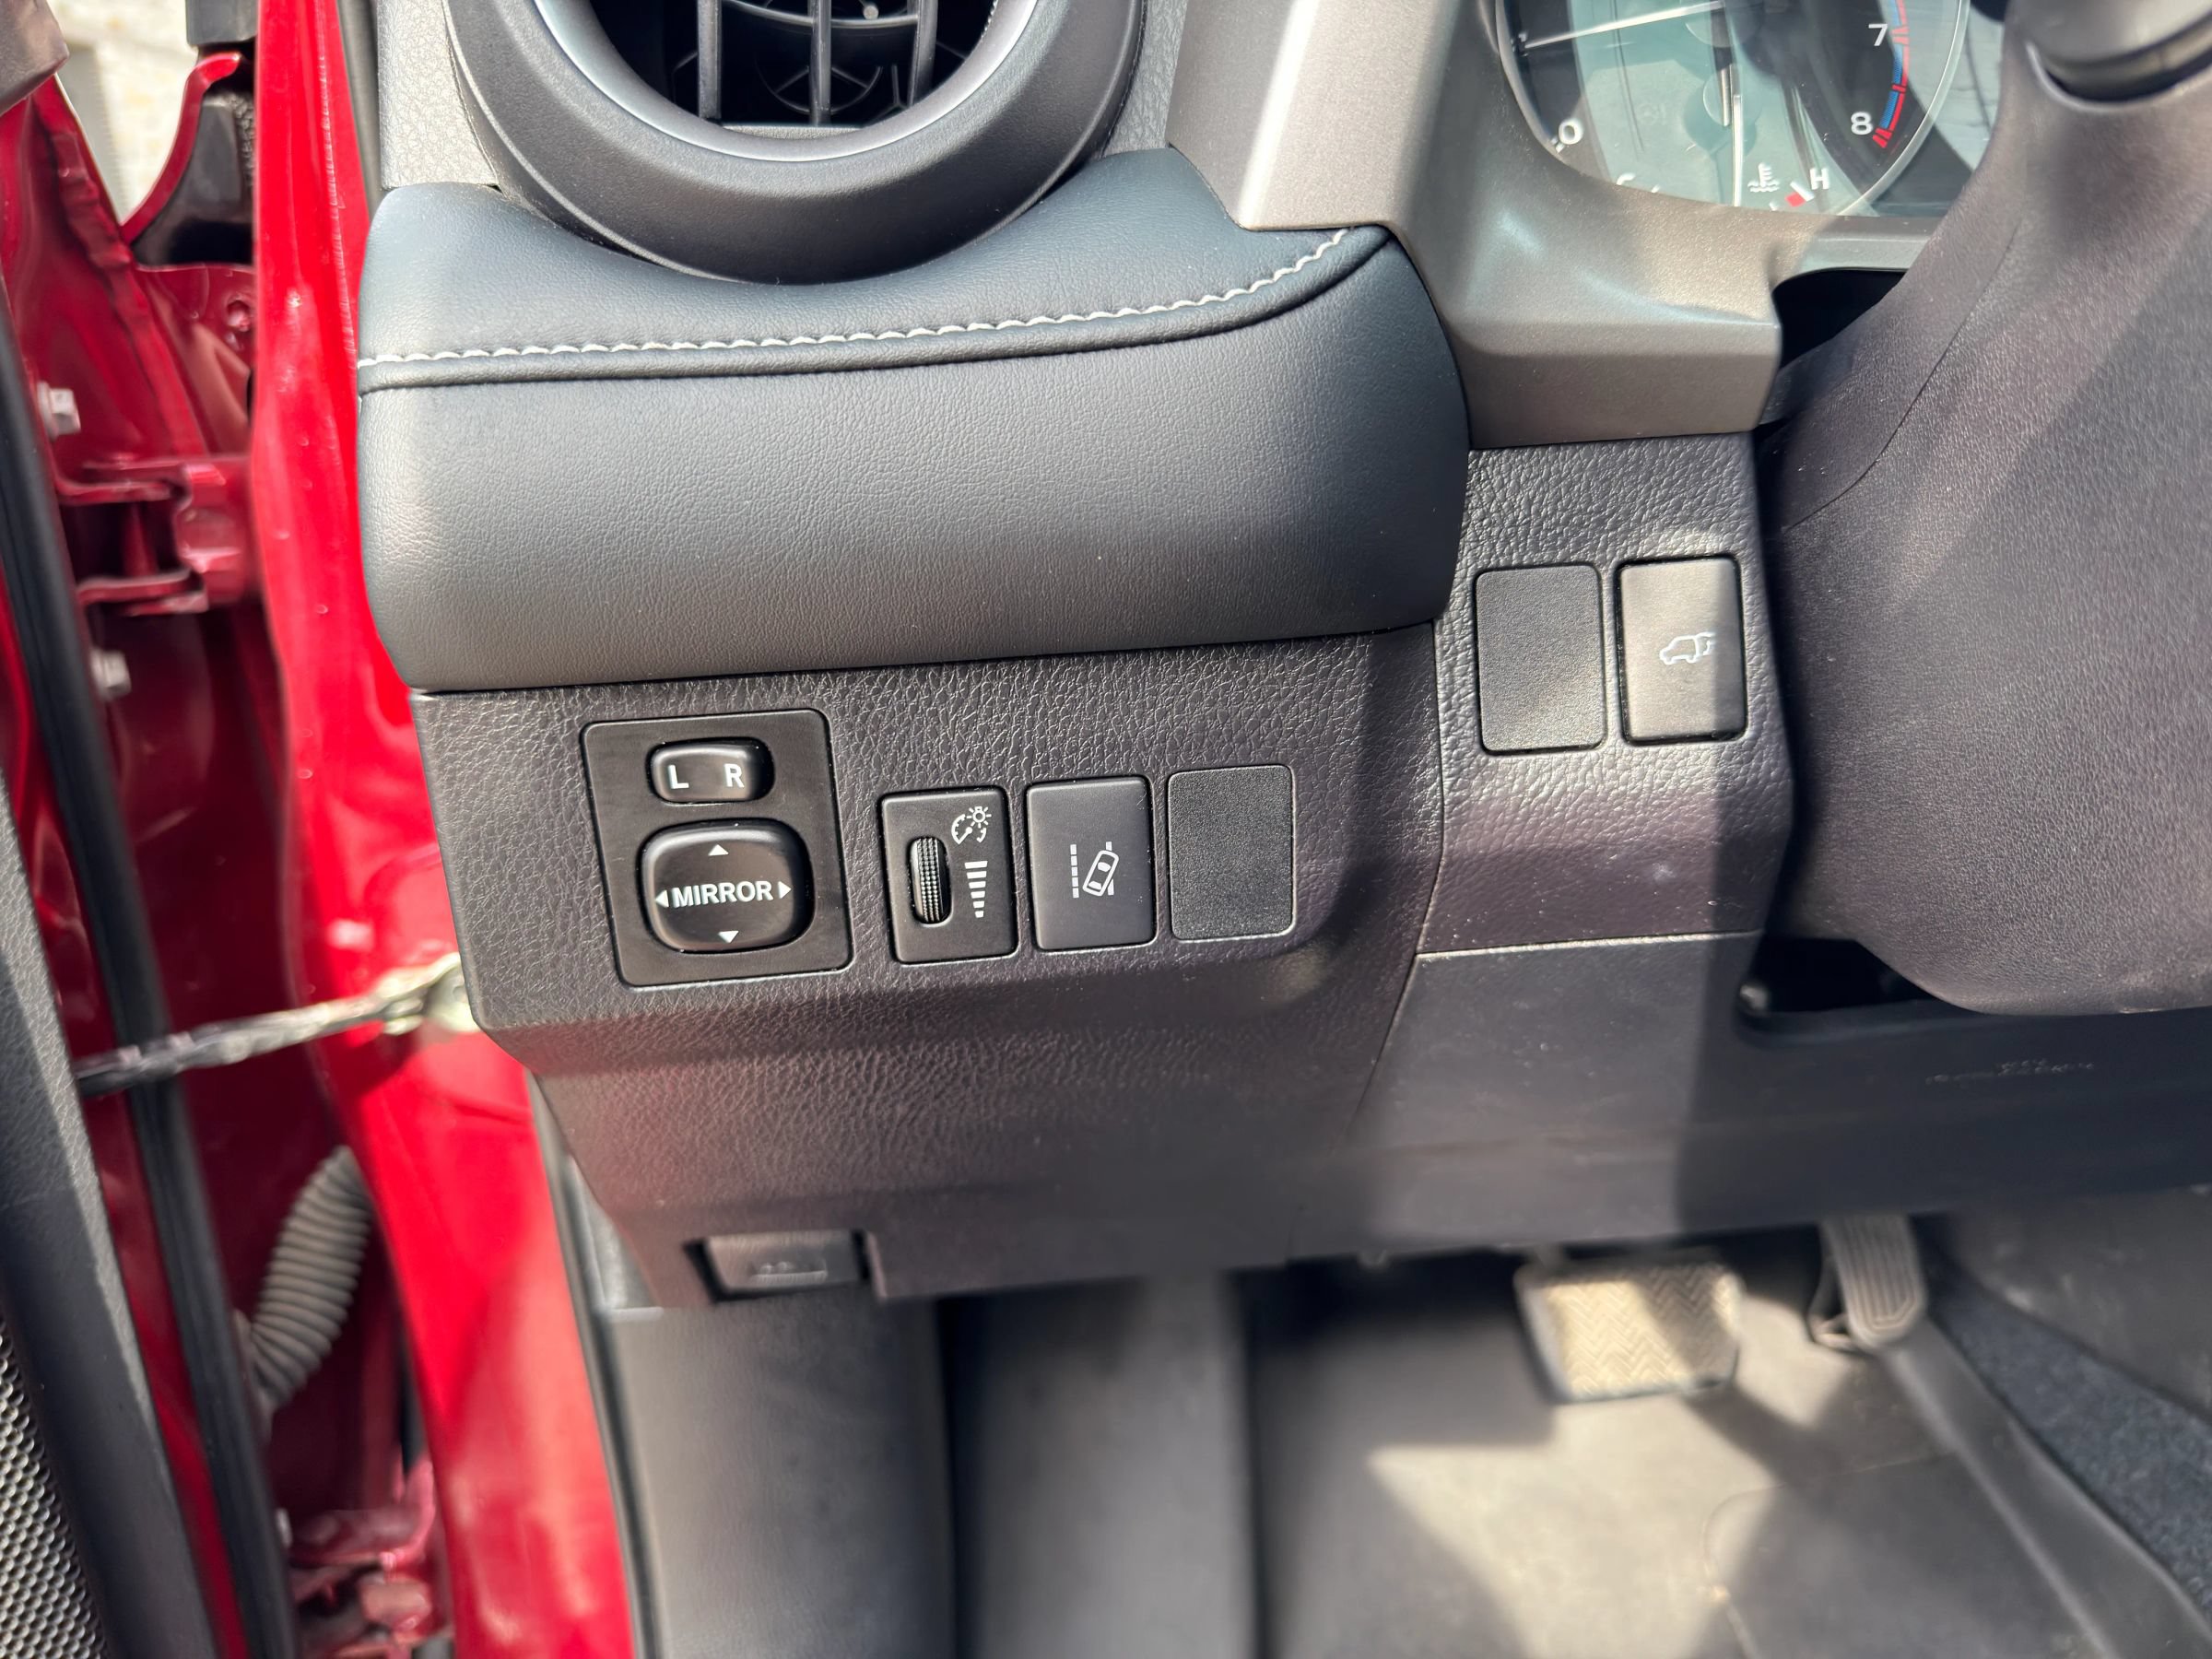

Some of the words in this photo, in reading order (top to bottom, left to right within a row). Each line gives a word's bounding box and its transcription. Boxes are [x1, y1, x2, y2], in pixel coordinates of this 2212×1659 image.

[1868, 23, 1888, 47] 7
[1850, 112, 1873, 135] 8
[1809, 167, 1830, 190] H
[667, 764, 689, 790] L
[724, 763, 745, 788] R
[671, 880, 774, 908] MIRROR
